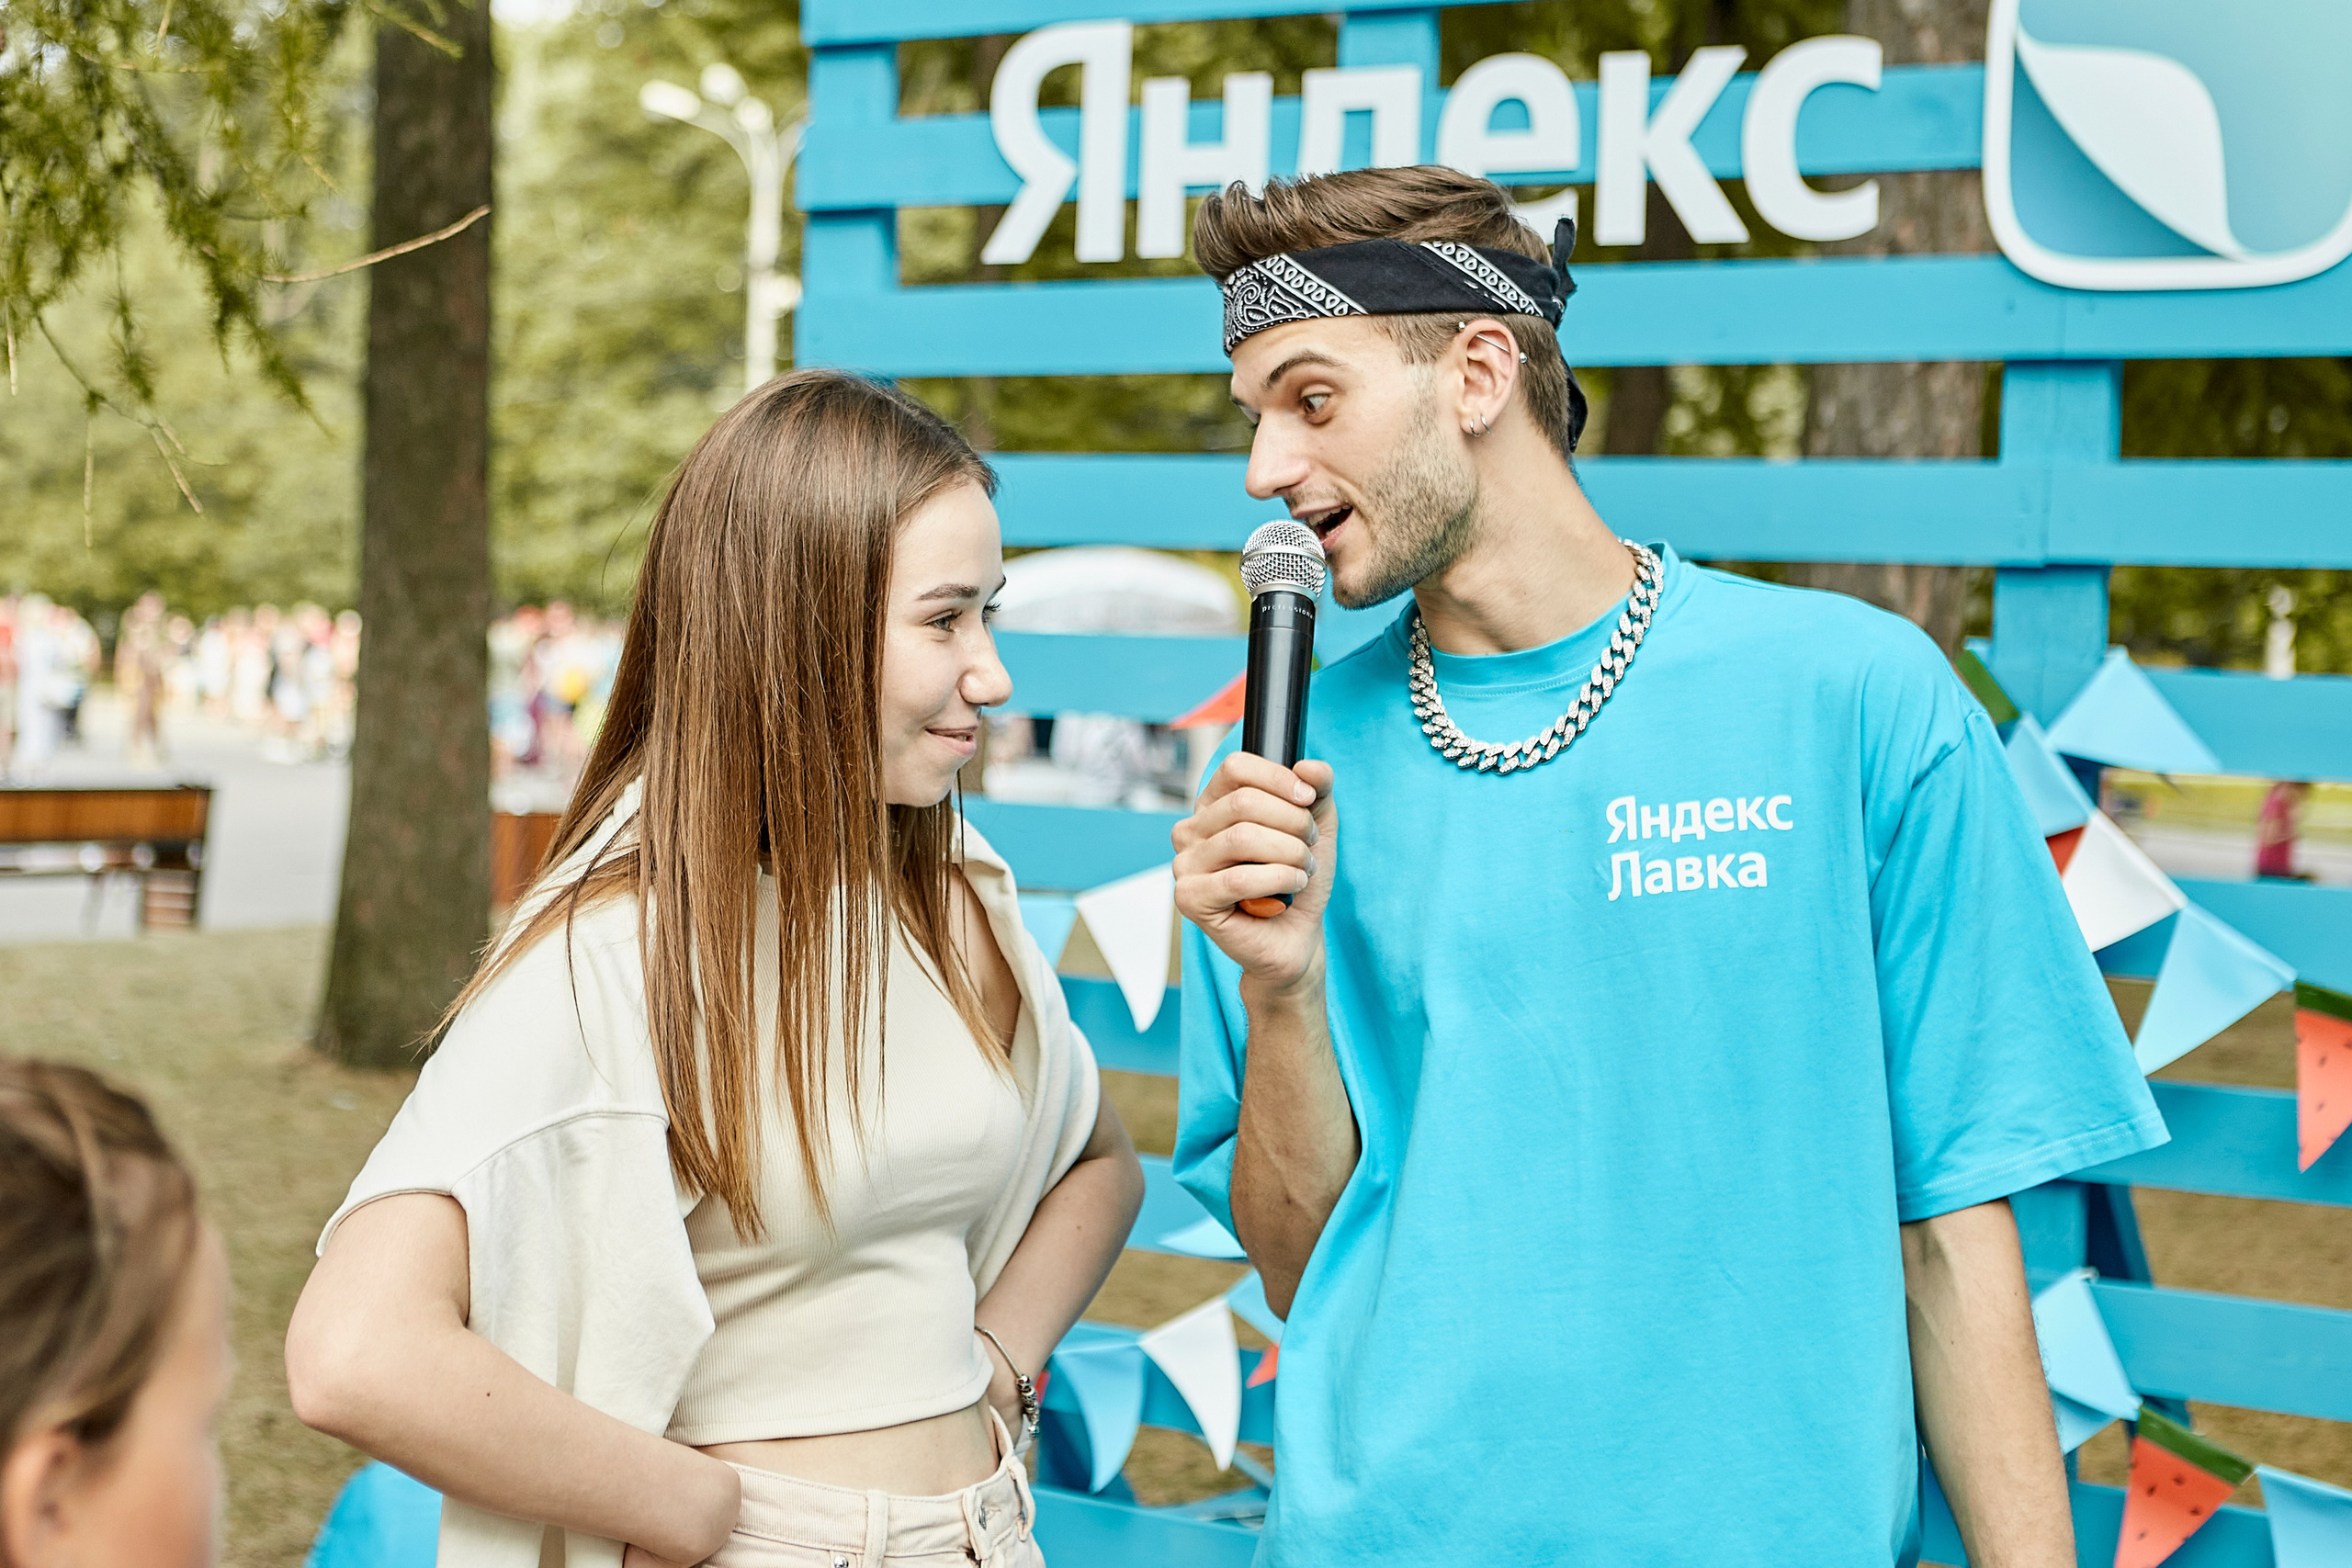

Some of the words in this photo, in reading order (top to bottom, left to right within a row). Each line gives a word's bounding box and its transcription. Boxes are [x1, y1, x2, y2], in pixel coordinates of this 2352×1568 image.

[1261, 604, 1314, 619] profssiona
[1606, 795, 1793, 843] Яндекс
[1608, 852, 1768, 901] Лавка
